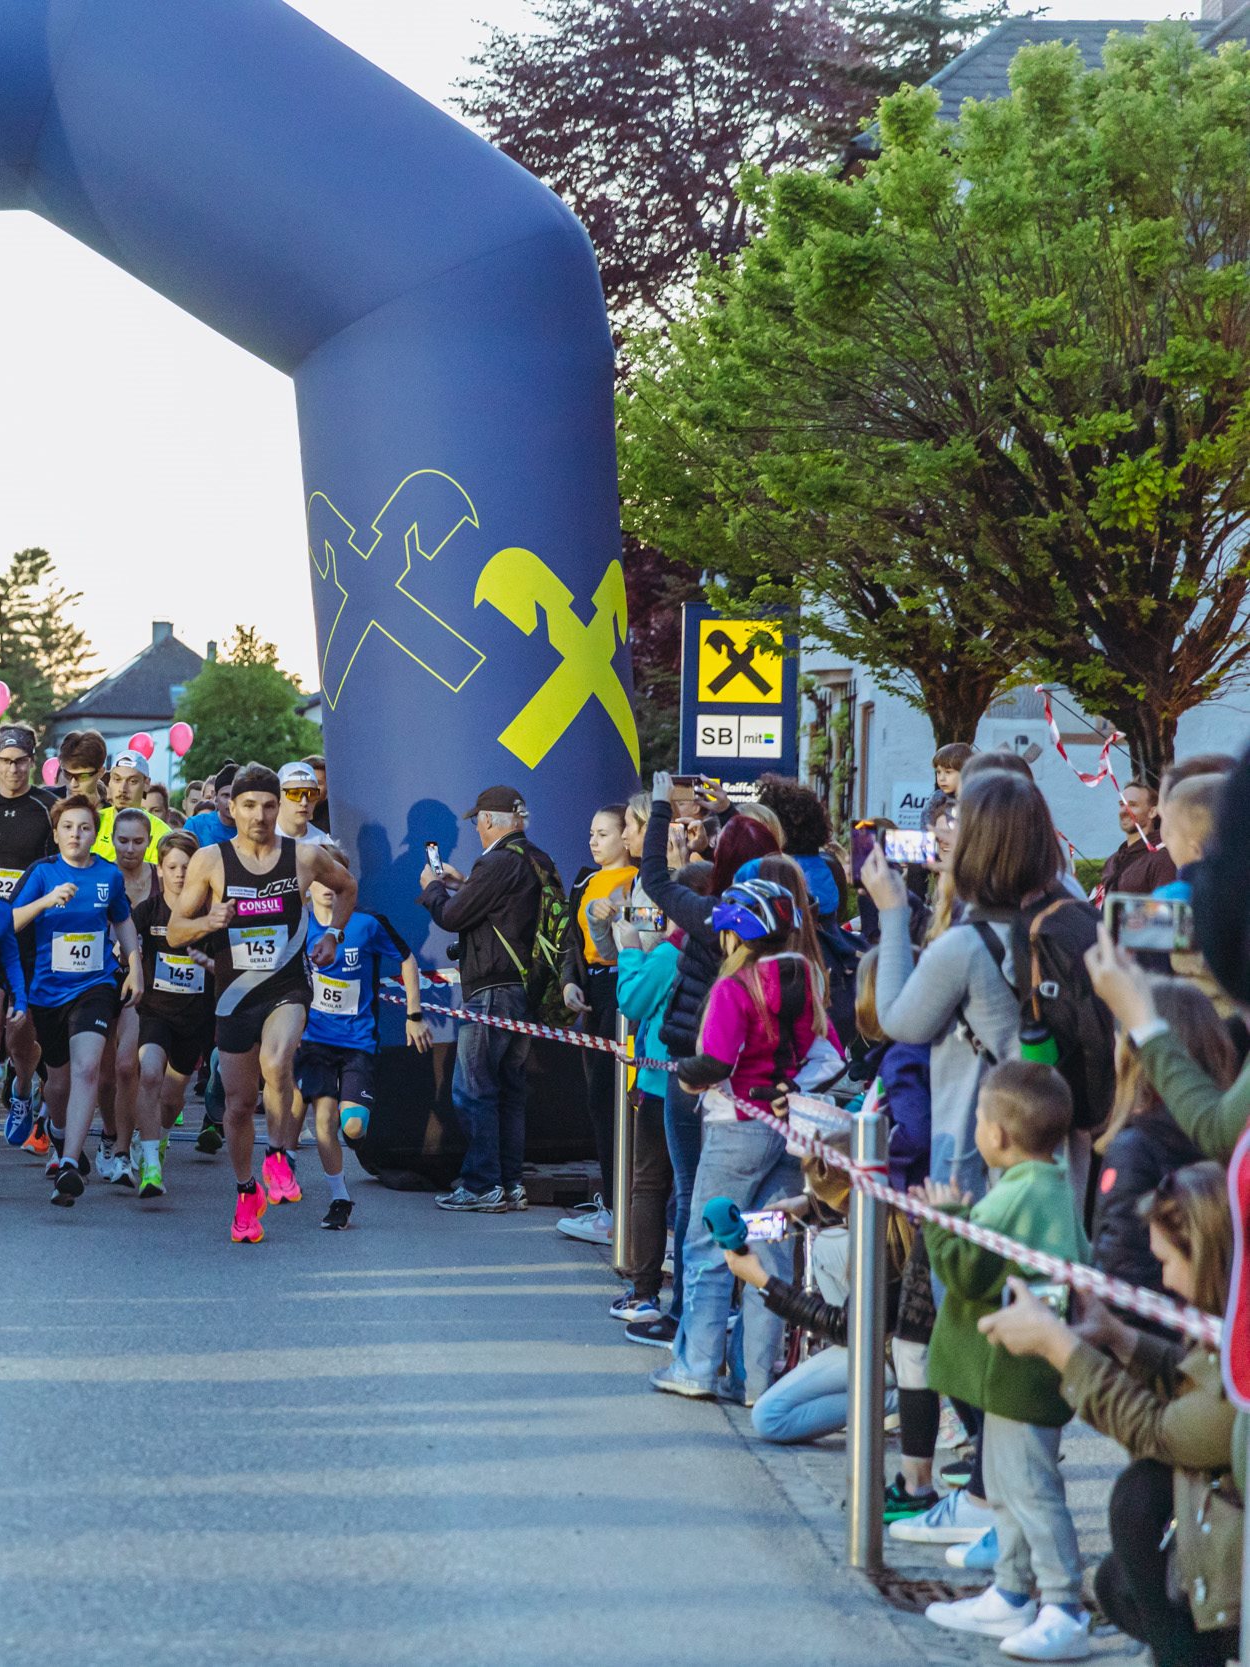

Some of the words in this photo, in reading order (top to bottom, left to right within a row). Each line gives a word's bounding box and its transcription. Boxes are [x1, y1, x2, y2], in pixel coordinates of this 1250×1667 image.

[702, 727, 733, 745] SB
[744, 733, 762, 744] mit
[899, 793, 929, 809] Au
[239, 898, 281, 912] CONSUL
[70, 945, 91, 959] 40
[245, 939, 276, 956] 143
[168, 966, 195, 981] 145
[323, 987, 342, 1002] 65
[320, 1000, 342, 1009] NICOLAS
